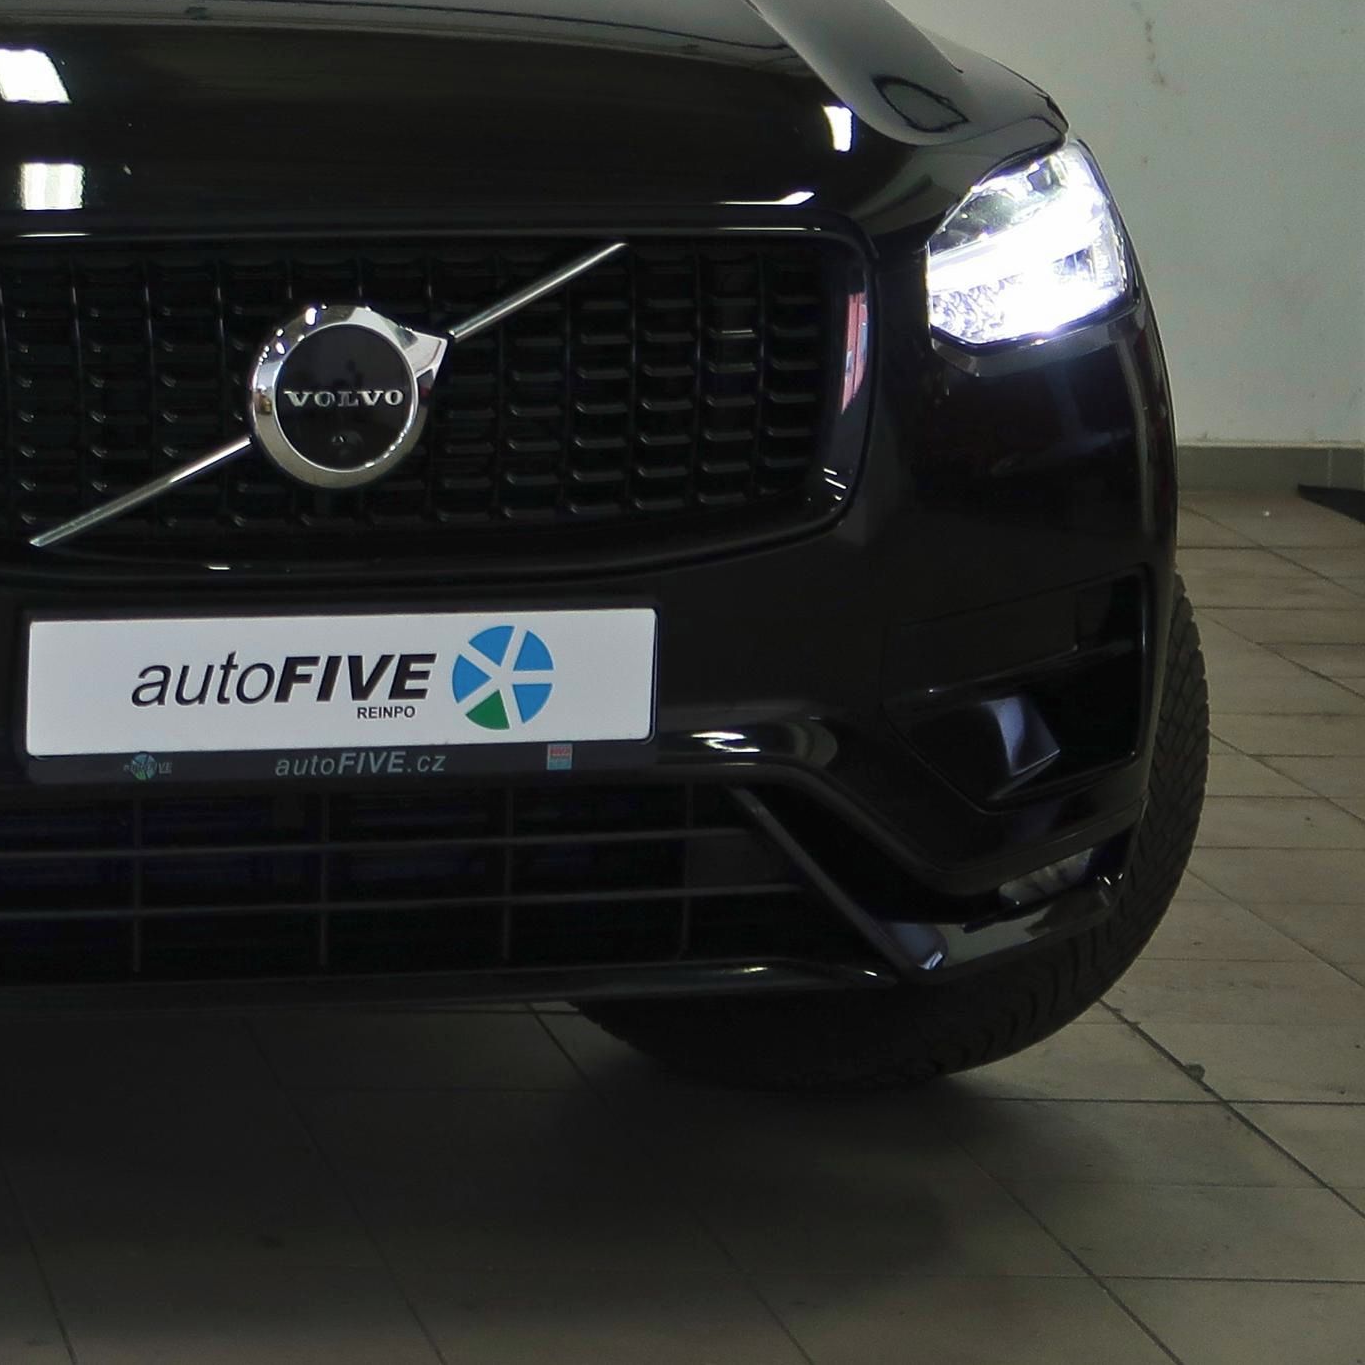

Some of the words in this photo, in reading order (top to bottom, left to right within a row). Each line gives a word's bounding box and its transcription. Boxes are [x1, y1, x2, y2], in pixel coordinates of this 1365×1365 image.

[283, 389, 404, 408] VOLVO
[131, 651, 437, 707] autoFIVE
[356, 706, 416, 719] REINPO
[274, 750, 447, 777] autoFIVE.cz
